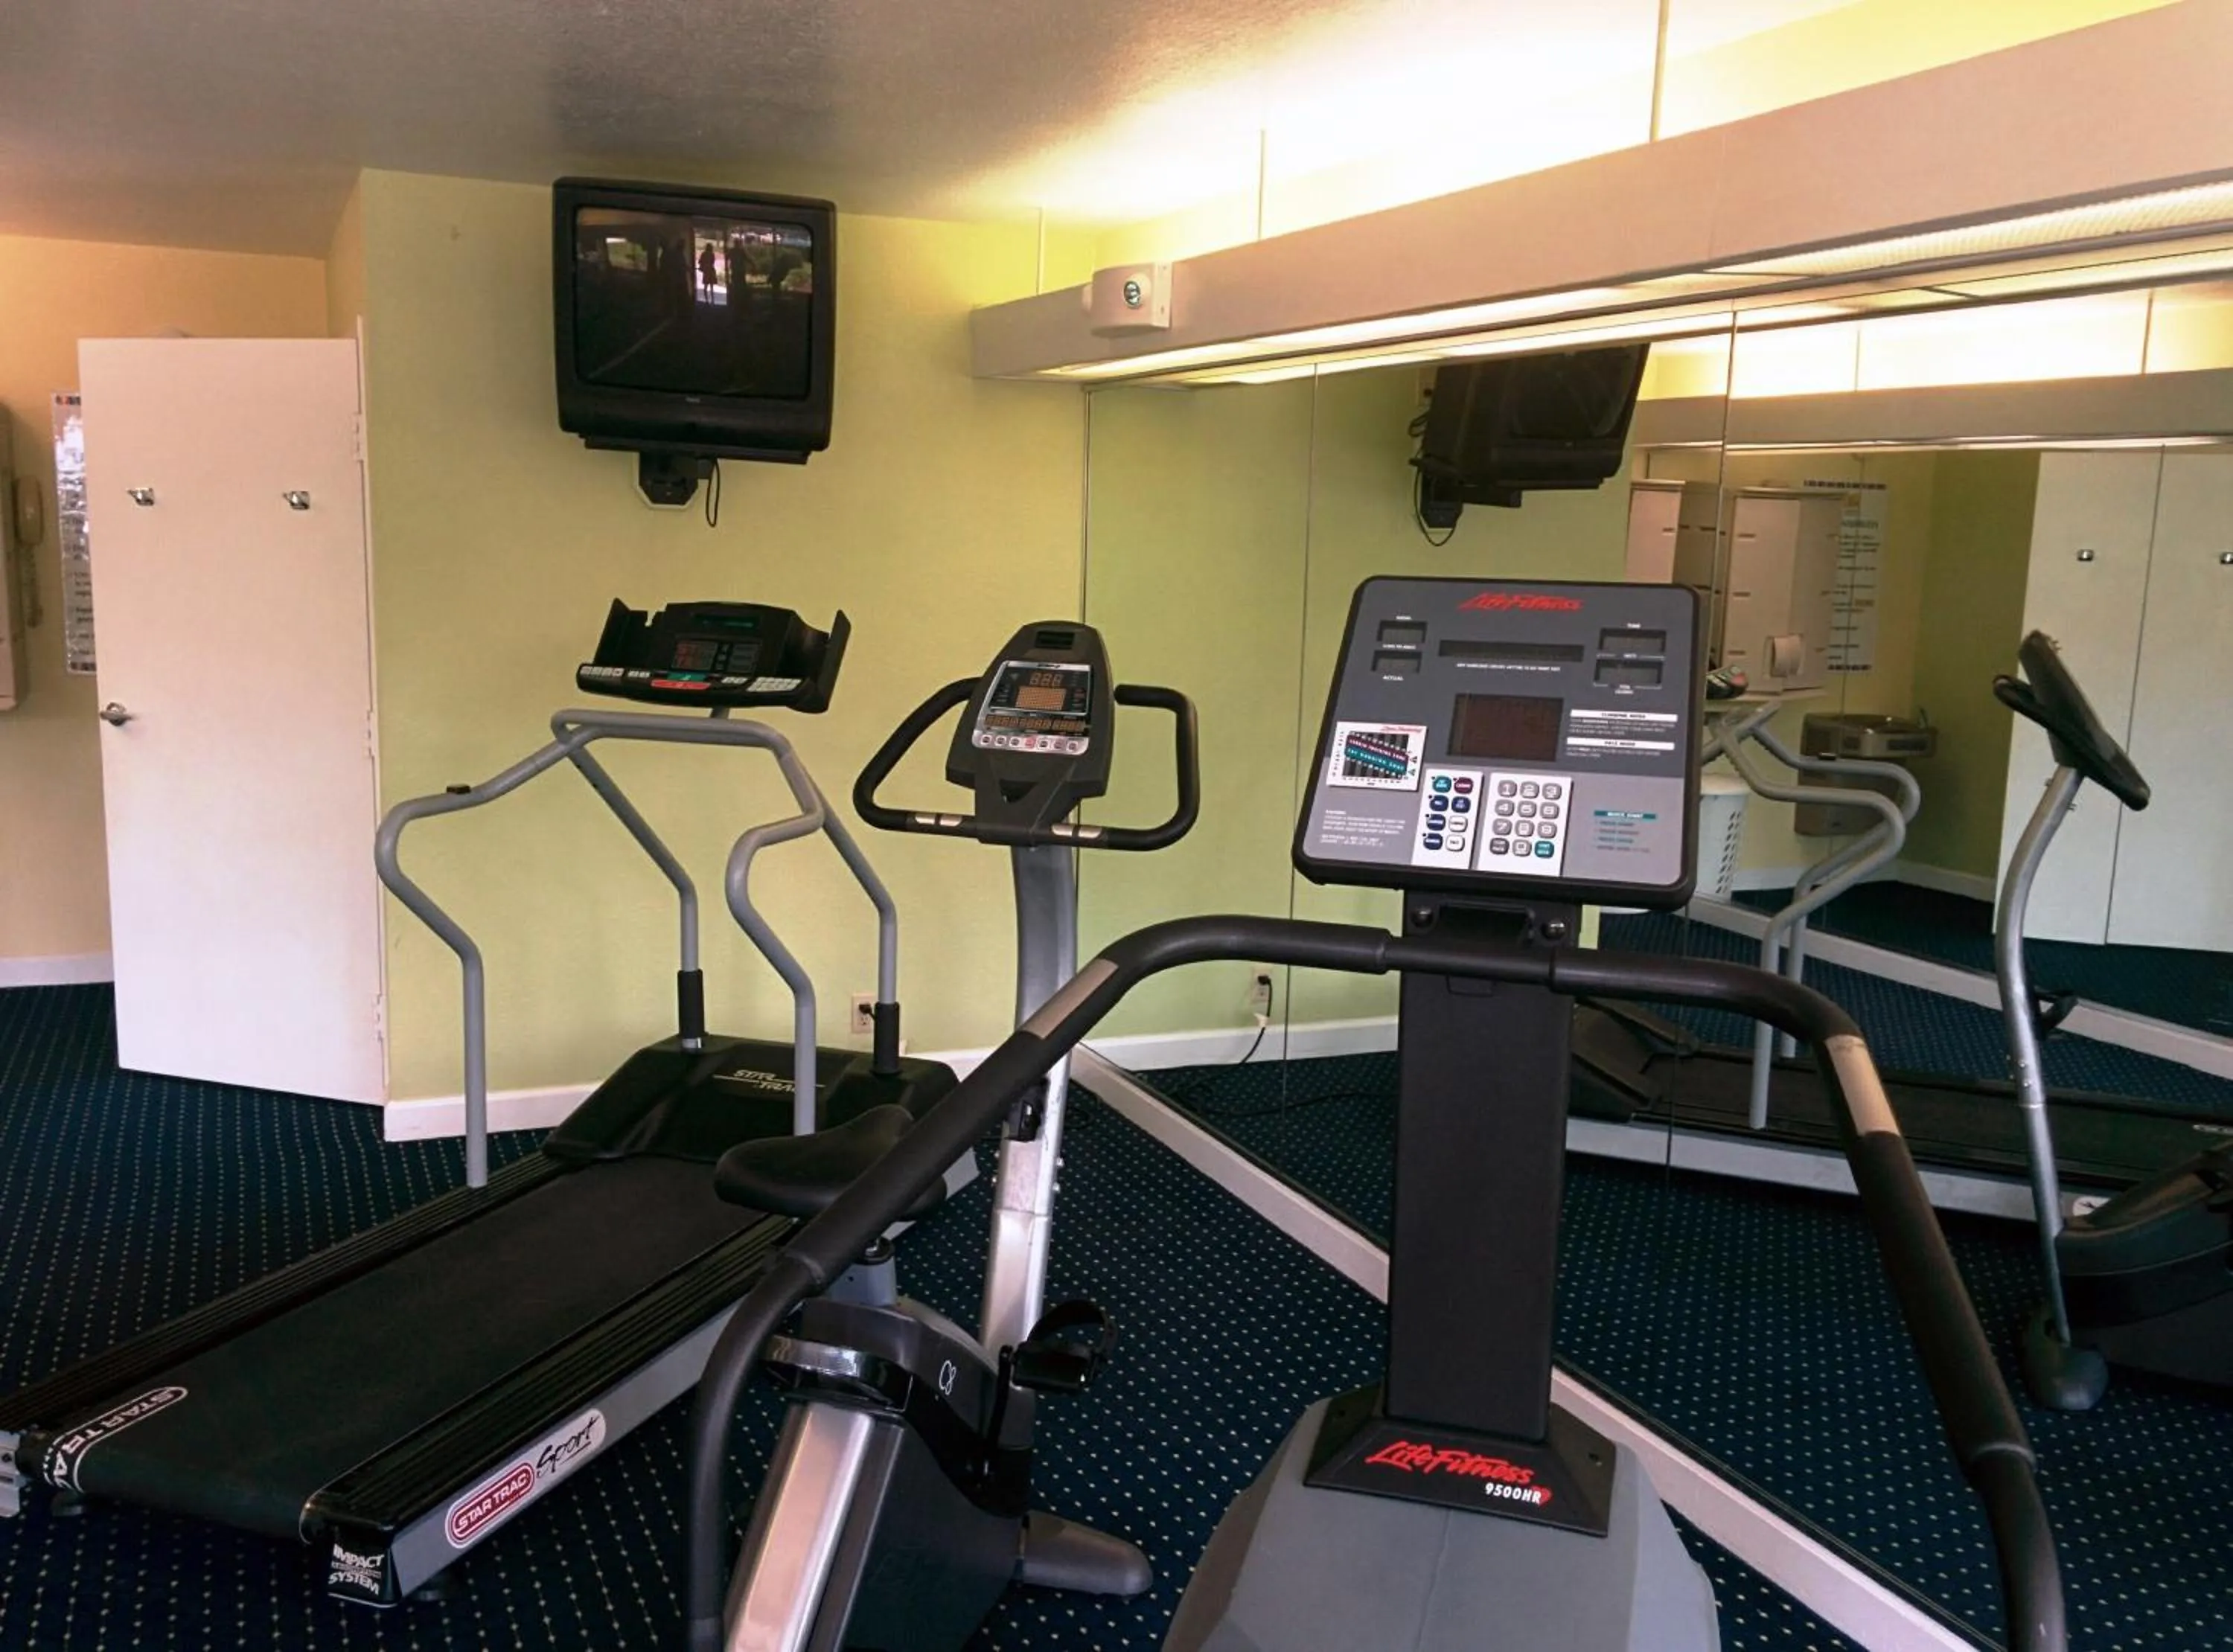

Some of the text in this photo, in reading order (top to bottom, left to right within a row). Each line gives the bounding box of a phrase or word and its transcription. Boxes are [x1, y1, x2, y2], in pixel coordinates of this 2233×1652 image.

[1502, 784, 1556, 798] 1 2 3
[1497, 822, 1507, 831] 7
[732, 1069, 776, 1080] STAR
[758, 1081, 796, 1094] TRA
[101, 1389, 174, 1428] STAR
[536, 1416, 600, 1478] Sport
[458, 1473, 528, 1529] STAR TRAC
[1485, 1482, 1542, 1505] 9500HR
[333, 1543, 386, 1568] IMPACT
[328, 1571, 380, 1595] SYSTEM
